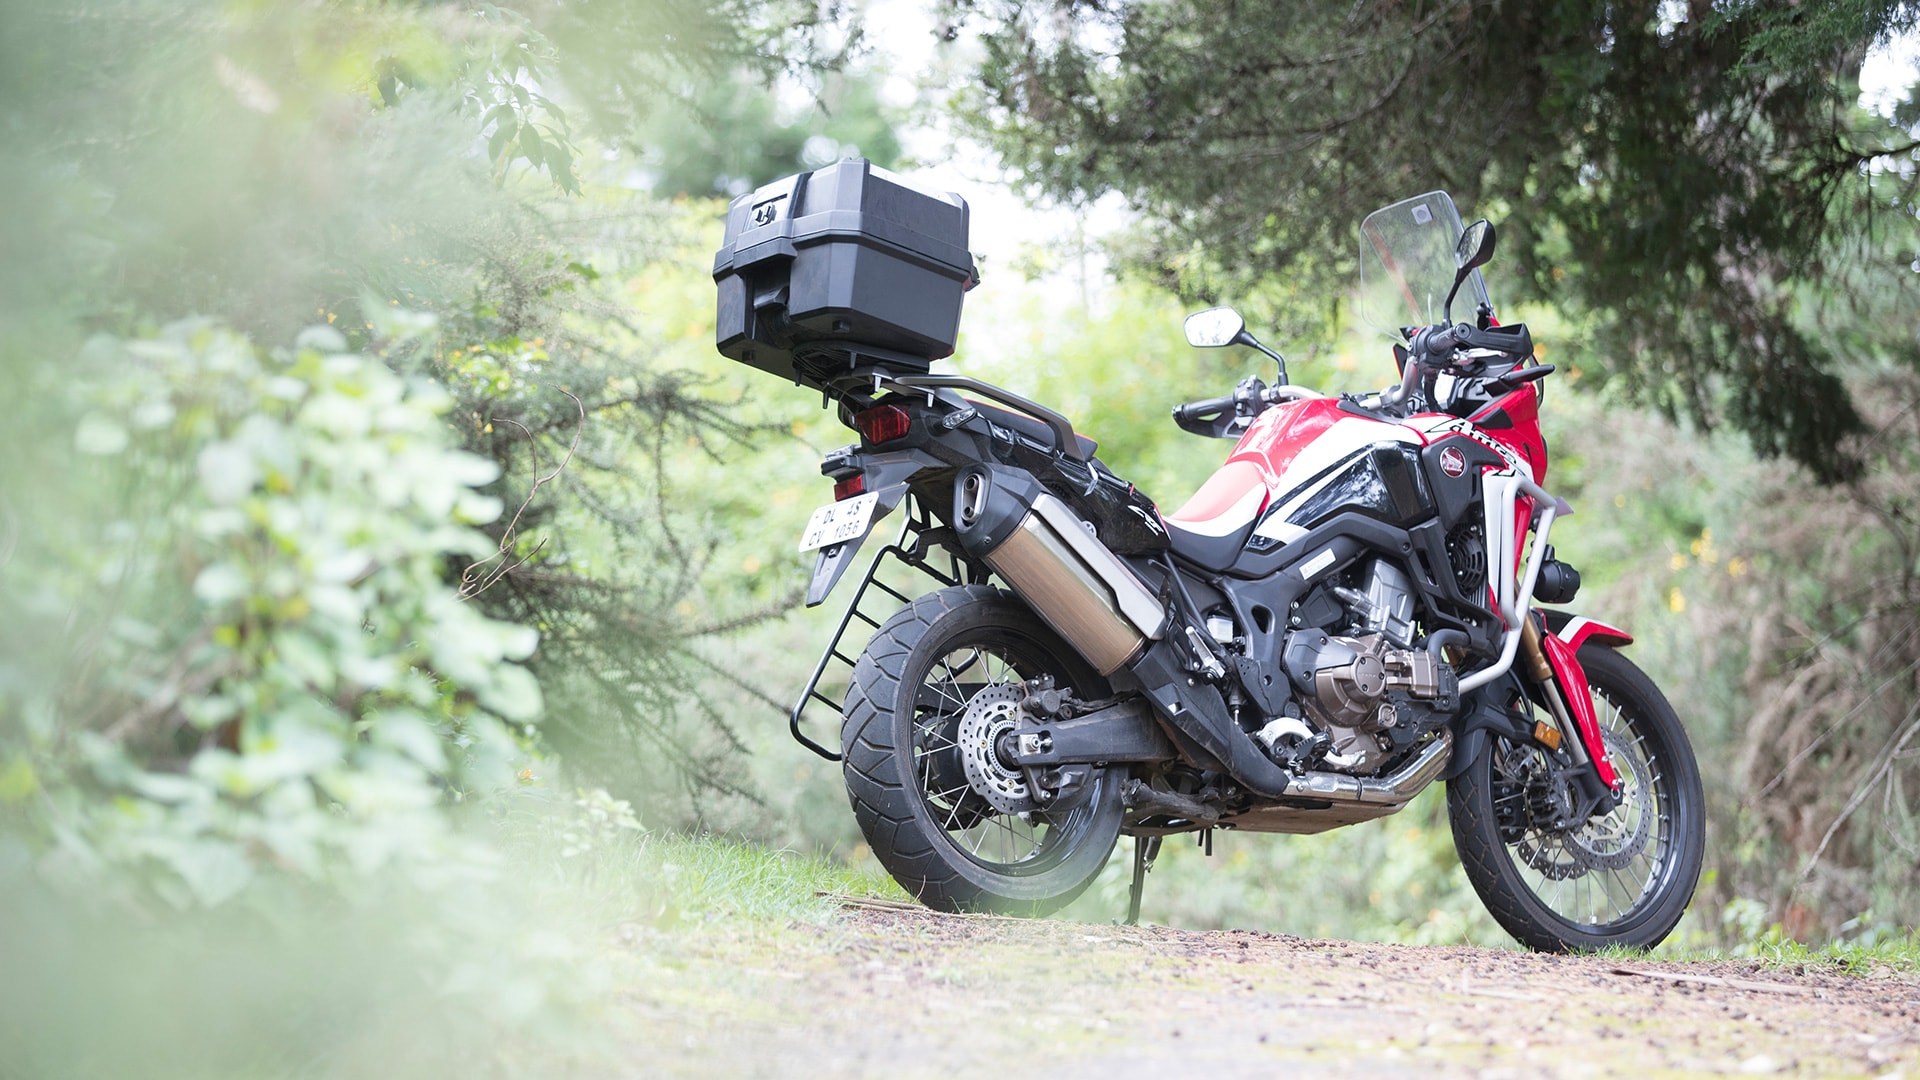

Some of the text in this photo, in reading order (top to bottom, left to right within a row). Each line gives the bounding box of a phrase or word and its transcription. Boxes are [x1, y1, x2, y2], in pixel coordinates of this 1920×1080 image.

[822, 507, 836, 525] DL
[808, 520, 860, 547] CV 1056
